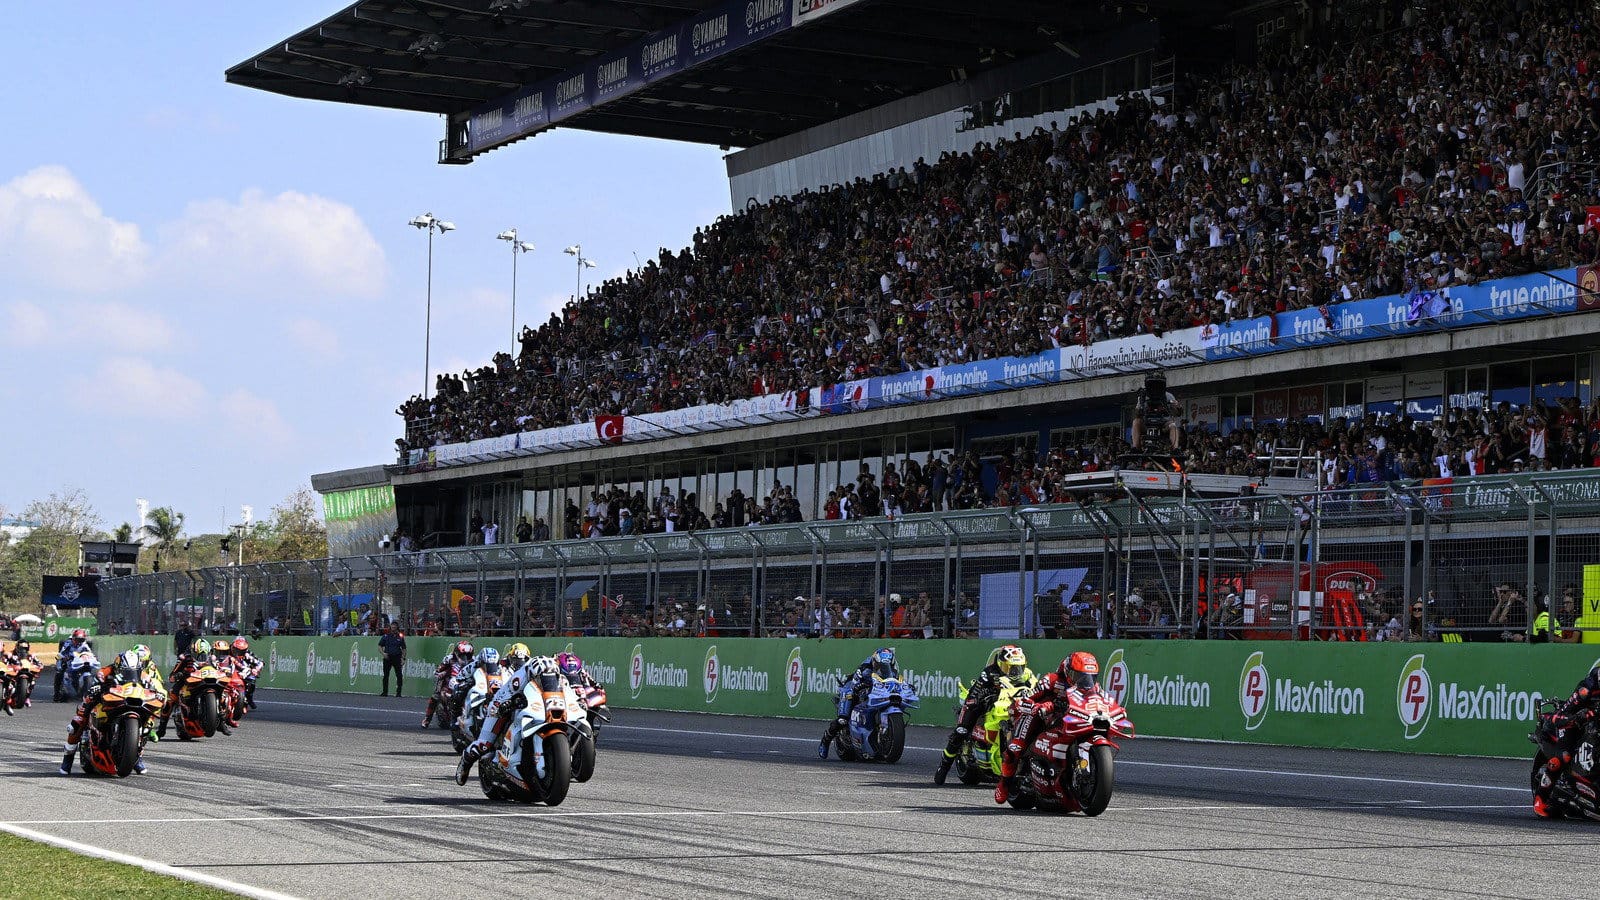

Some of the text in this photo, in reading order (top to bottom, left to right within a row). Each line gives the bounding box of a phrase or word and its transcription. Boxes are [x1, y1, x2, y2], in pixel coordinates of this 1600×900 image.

[700, 14, 728, 45] YAMAHA
[650, 34, 677, 65] YAMAHA
[695, 40, 726, 56] RACING
[603, 57, 628, 85] YAMAHA
[644, 60, 675, 77] RACING
[563, 73, 585, 101] YAMAHA
[599, 81, 627, 95] RACING
[521, 92, 543, 118] YAMAHA
[1491, 284, 1529, 316] true
[1531, 278, 1575, 310] online
[1294, 316, 1326, 343] true
[941, 367, 988, 393] true online
[1004, 355, 1054, 383] true online
[881, 380, 902, 402] true
[1271, 602, 1288, 612] Lenovo
[646, 662, 688, 688] Maxnitron
[722, 665, 768, 692] Maxnitron
[1134, 673, 1210, 708] Maxnitron
[1275, 678, 1364, 715] Maxnitron
[1439, 682, 1543, 722] Maxnitron
[1020, 714, 1034, 740] DUCATI
[1069, 708, 1090, 721] Lenovo
